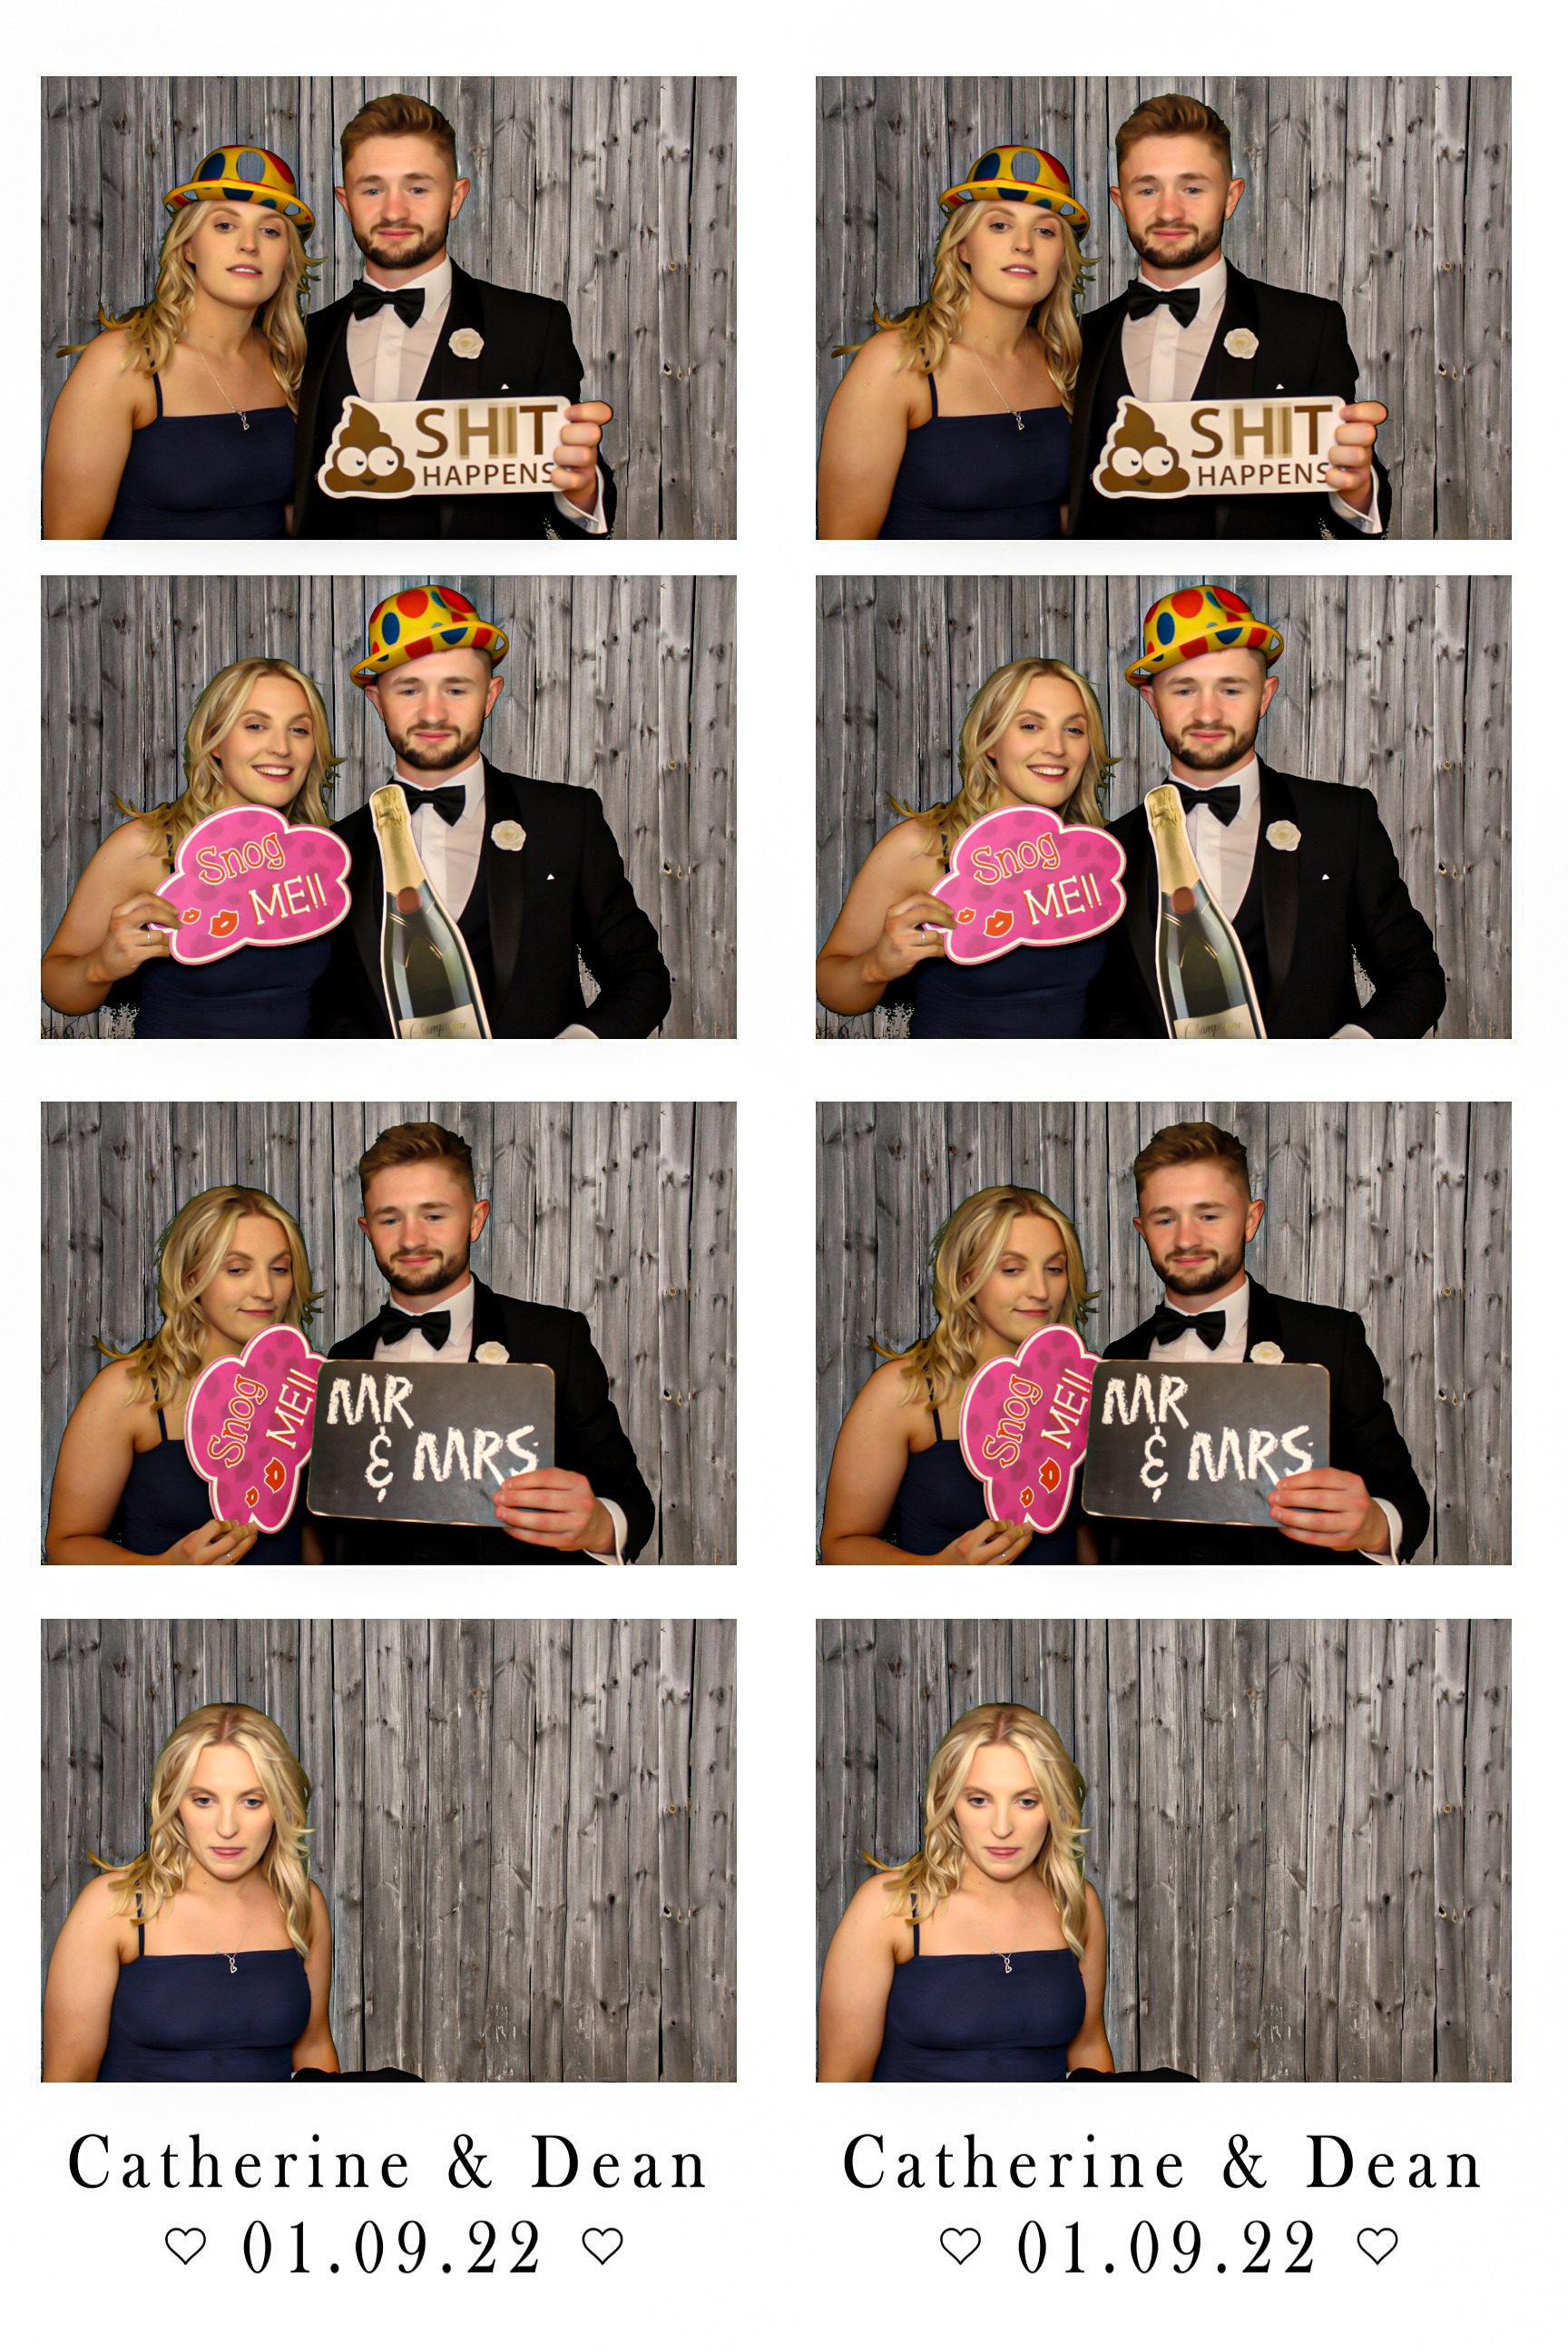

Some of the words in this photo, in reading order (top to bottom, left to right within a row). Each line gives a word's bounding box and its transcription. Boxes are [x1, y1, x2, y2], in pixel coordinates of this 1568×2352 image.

[415, 404, 558, 459] SHIT
[1190, 404, 1333, 459] SHIT
[423, 462, 554, 486] HAPPENS
[1198, 462, 1328, 486] HAPPENS
[196, 832, 286, 885] Snog
[971, 832, 1061, 885] Snog
[248, 872, 328, 926] ME!!
[1023, 872, 1102, 926] ME!!
[207, 1374, 268, 1468] Snog
[327, 1373, 415, 1429] MR
[982, 1374, 1043, 1468] Snog
[1102, 1373, 1190, 1429] MR
[365, 1426, 393, 1503] &
[413, 1425, 539, 1485] MRS
[1140, 1426, 1168, 1503] &
[1188, 1425, 1314, 1485] MRS
